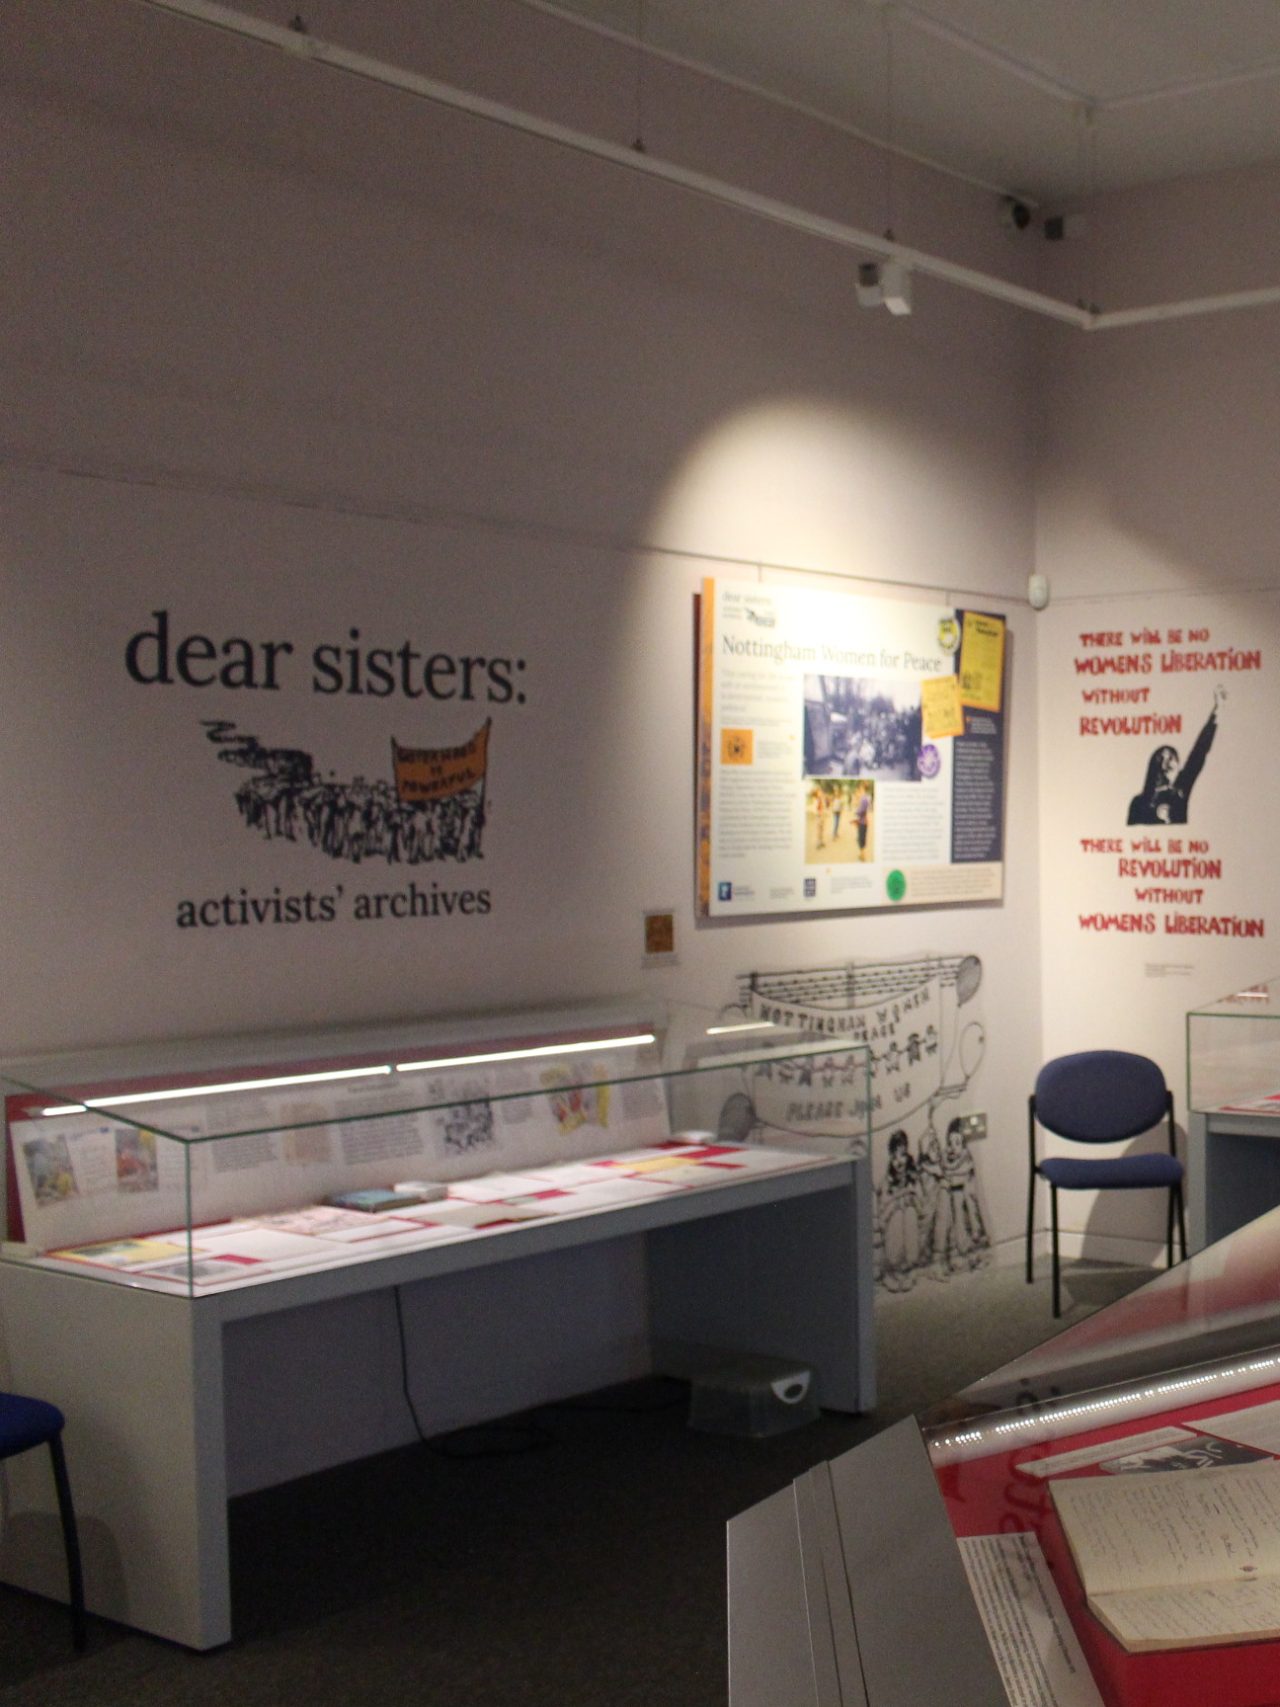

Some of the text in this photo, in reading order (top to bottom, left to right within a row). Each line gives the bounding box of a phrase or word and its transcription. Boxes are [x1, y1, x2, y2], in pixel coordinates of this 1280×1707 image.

[1079, 630, 1123, 648] THERE
[1167, 629, 1182, 645] BE
[1188, 627, 1211, 643] NO
[124, 610, 526, 704] dear sisters:
[722, 634, 942, 672] Nottingham Women for Peace
[1074, 649, 1152, 676] WOMENS
[1080, 839, 1123, 854] THERE
[1168, 838, 1183, 854] BE
[1188, 838, 1209, 853] NO
[353, 882, 491, 920] archives
[1078, 912, 1156, 934] WOMENS
